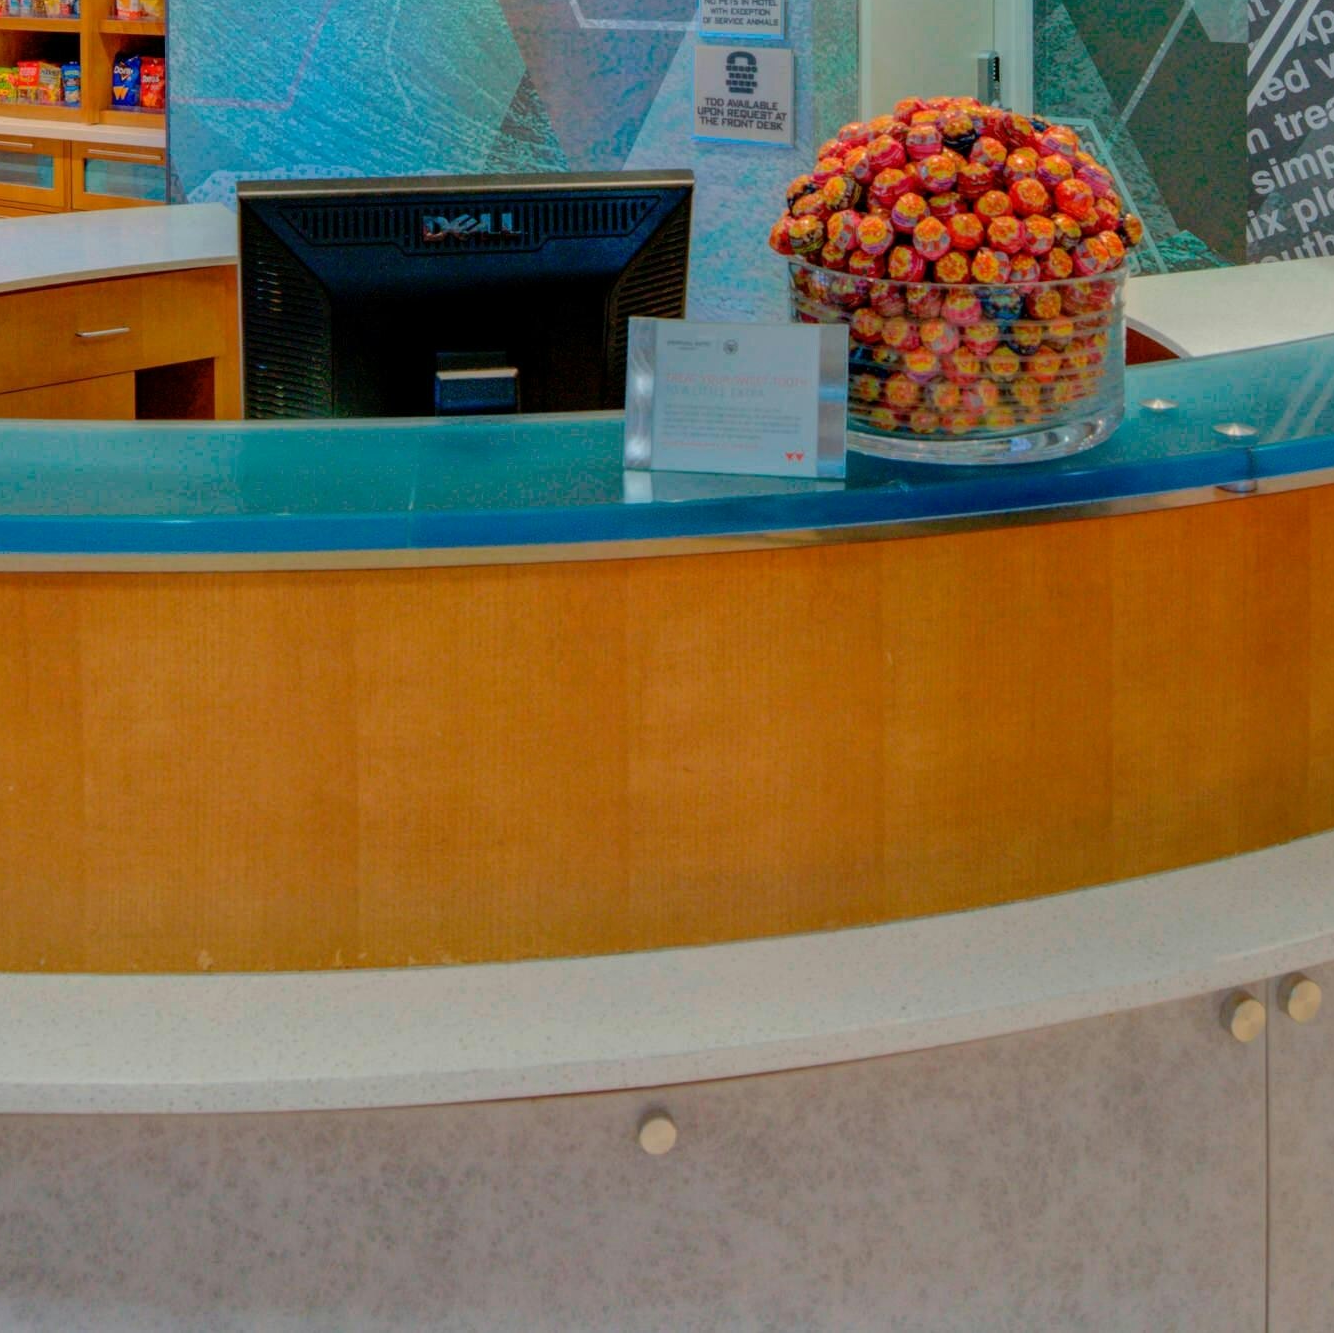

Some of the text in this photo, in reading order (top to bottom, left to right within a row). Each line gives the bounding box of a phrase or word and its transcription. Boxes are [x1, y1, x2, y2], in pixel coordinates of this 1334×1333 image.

[731, 8, 771, 16] EXCEPTION
[714, 17, 744, 25] SERVICE
[705, 97, 779, 111] TDD AVAILABLE
[697, 106, 787, 121] UPON REQUEST AT
[699, 116, 783, 131] THE FRONT DESK
[423, 213, 521, 241] DELL
